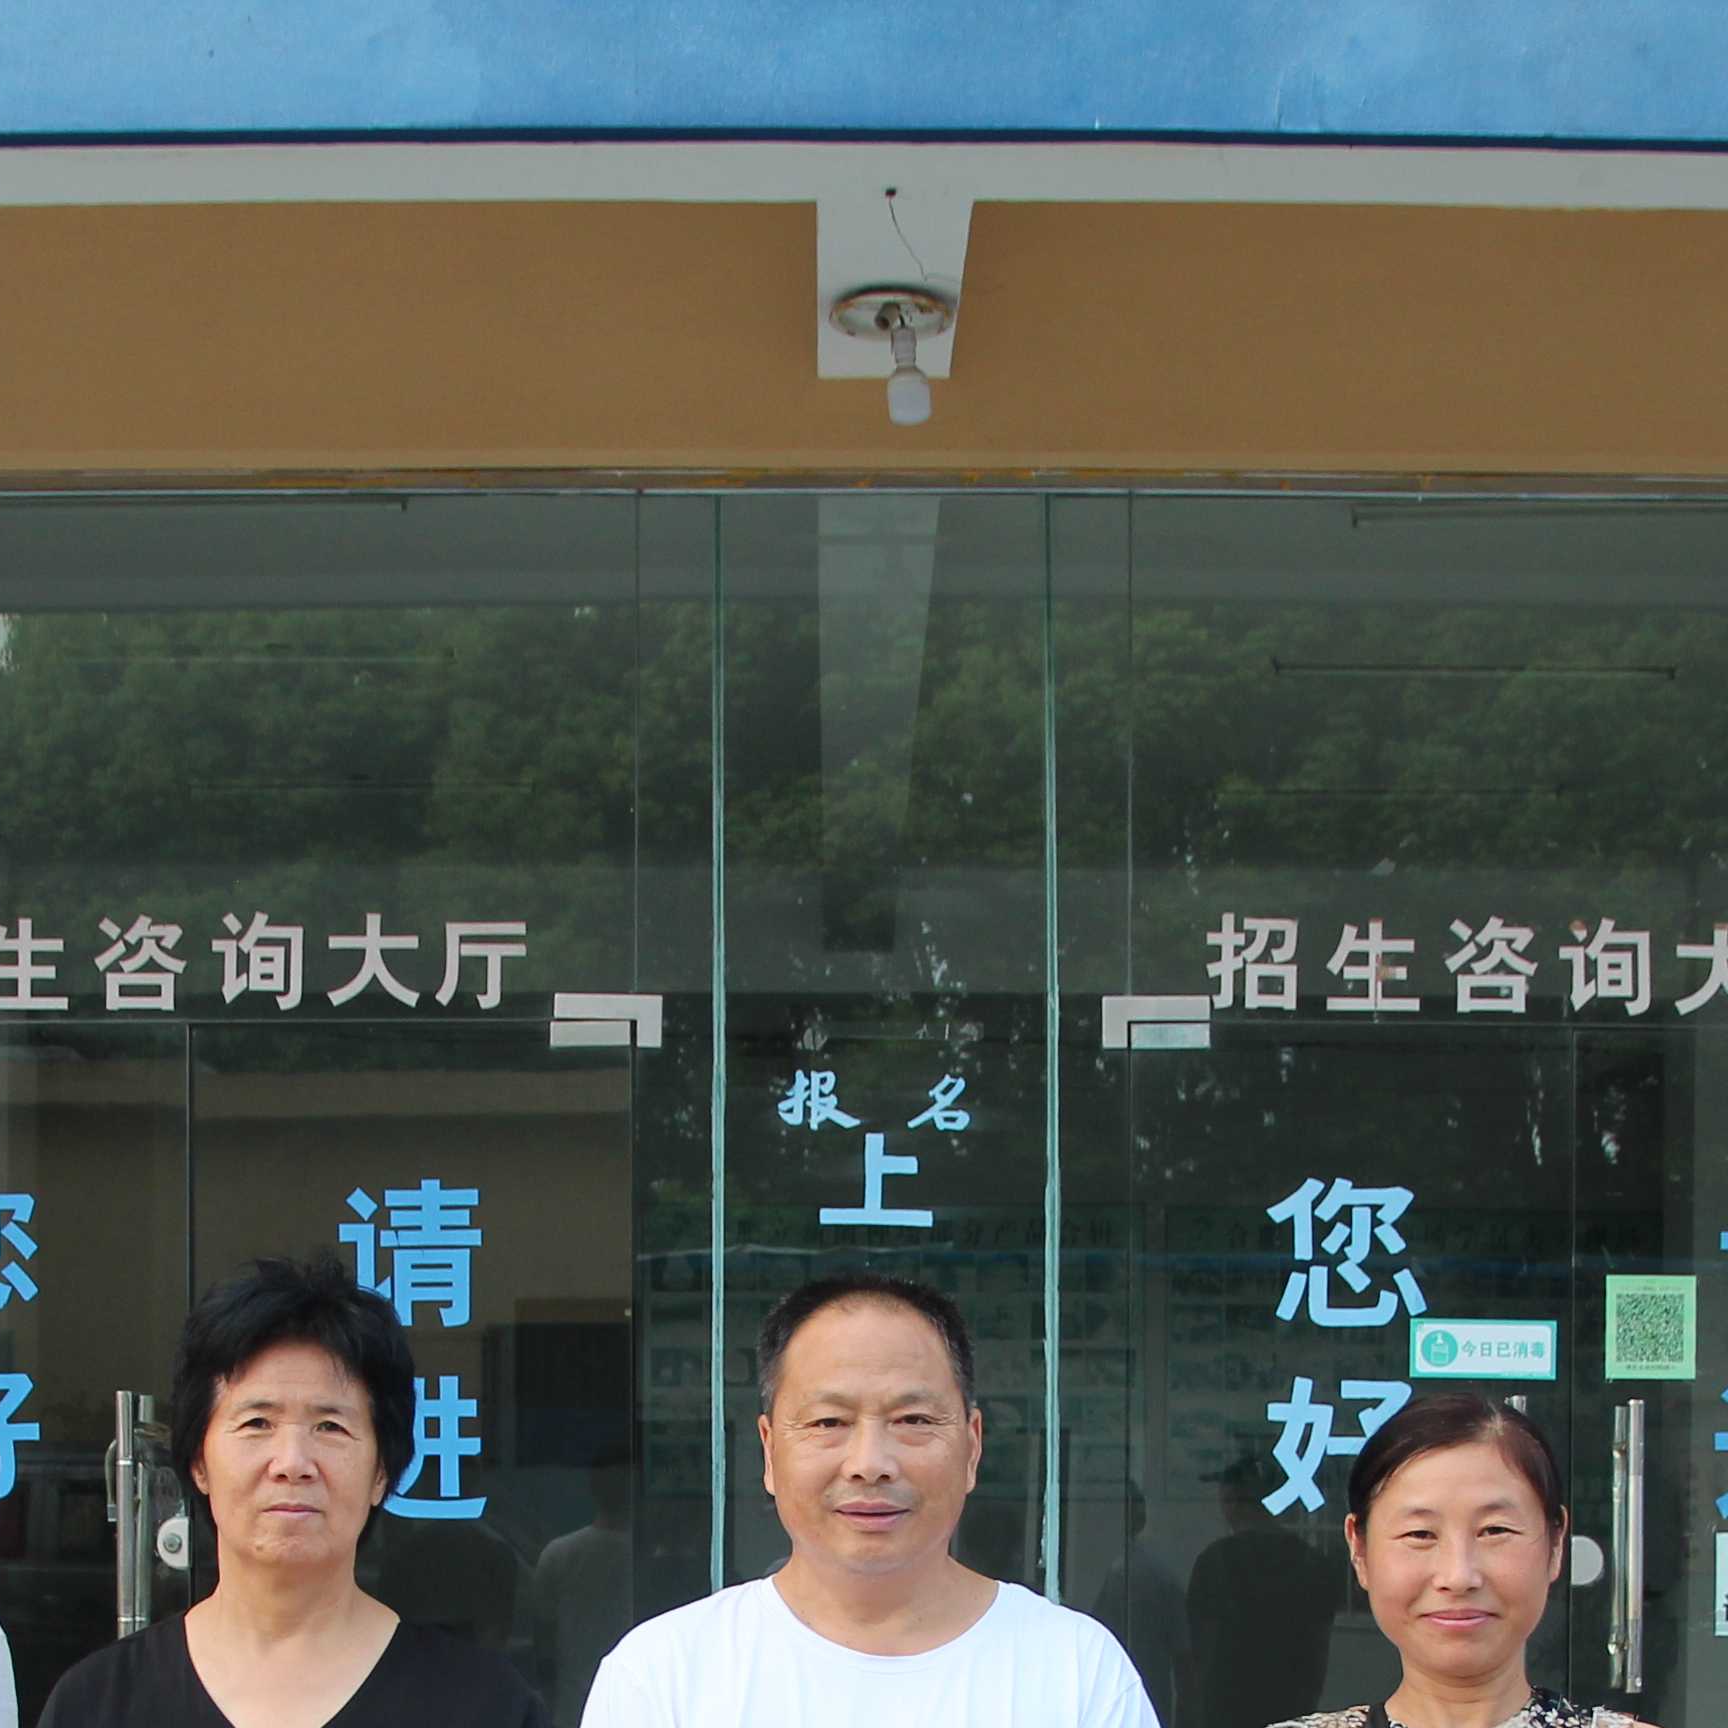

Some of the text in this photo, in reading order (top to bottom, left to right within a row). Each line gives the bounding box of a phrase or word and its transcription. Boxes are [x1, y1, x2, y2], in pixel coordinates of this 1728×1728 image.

[1461, 1339, 1545, 1360] 今日已消毒
